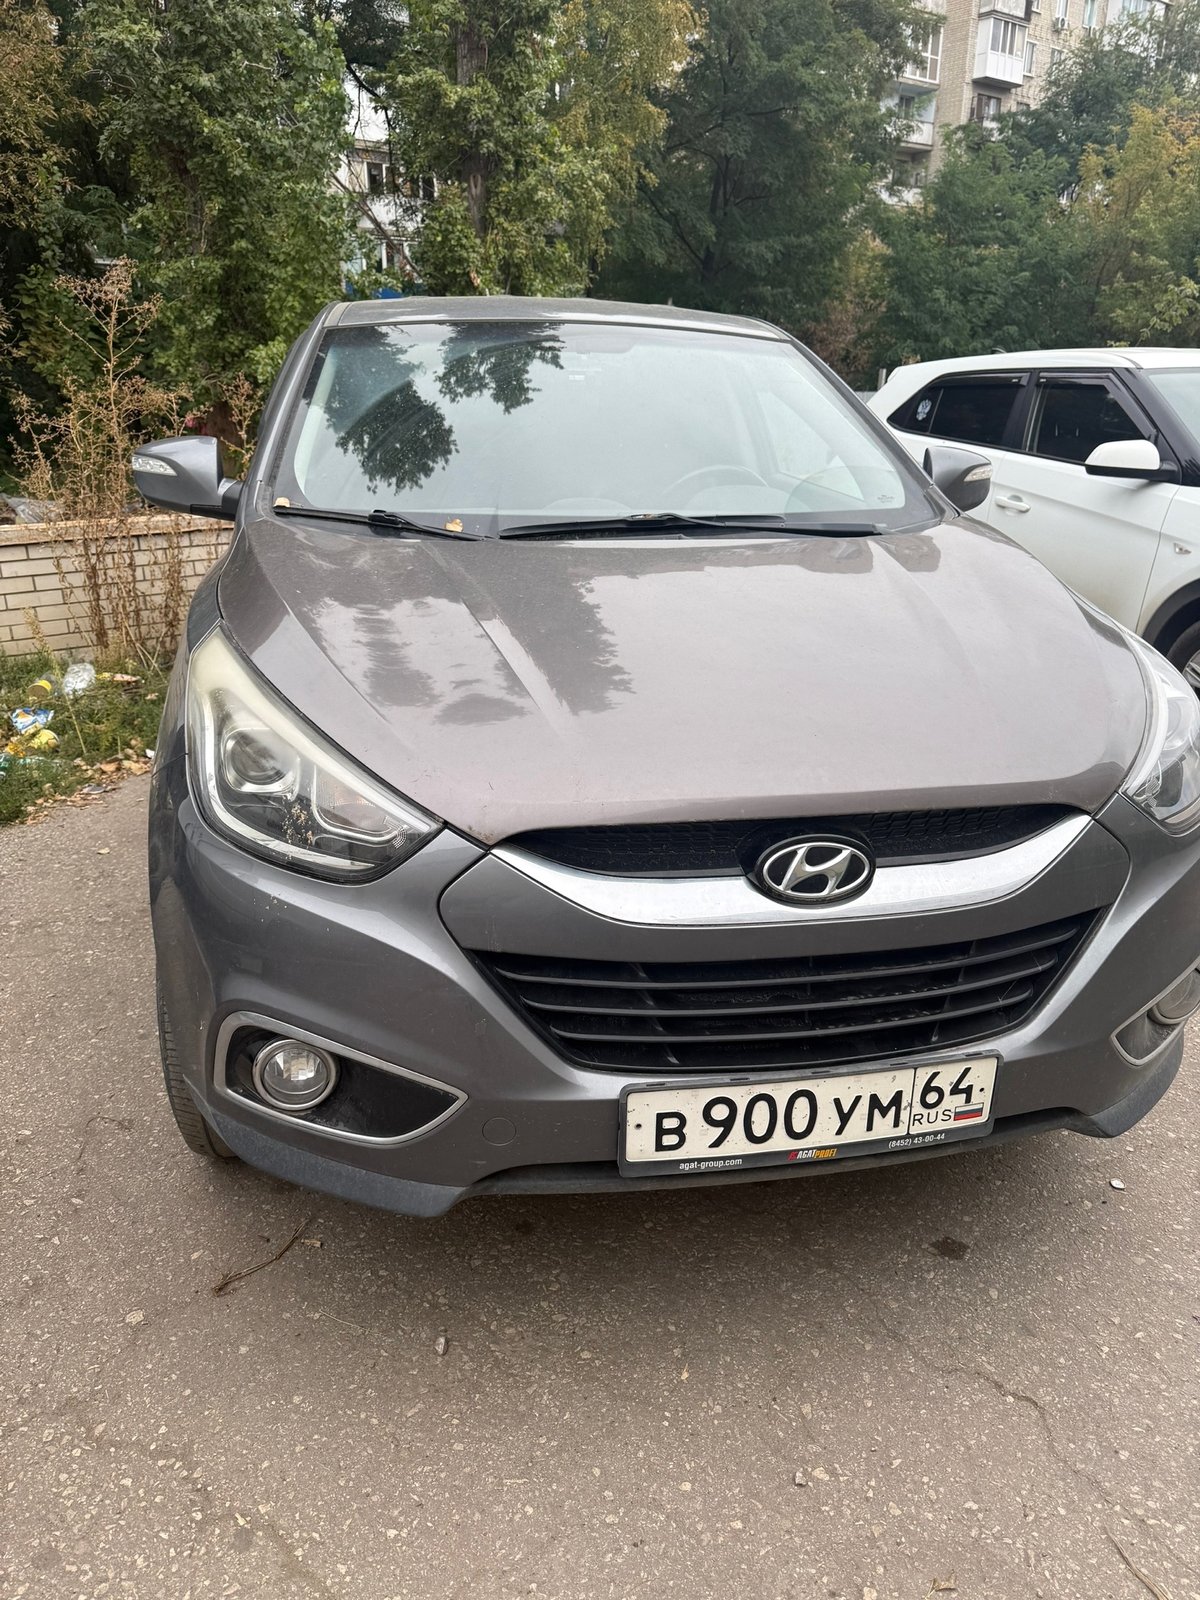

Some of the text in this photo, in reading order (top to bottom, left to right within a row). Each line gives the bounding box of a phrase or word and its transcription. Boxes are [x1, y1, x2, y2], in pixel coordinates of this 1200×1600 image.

[920, 1067, 974, 1110] 64
[912, 1109, 952, 1126] RUS
[888, 1133, 946, 1149] (8452) 43-00-44
[679, 1158, 743, 1171] agat-group.com
